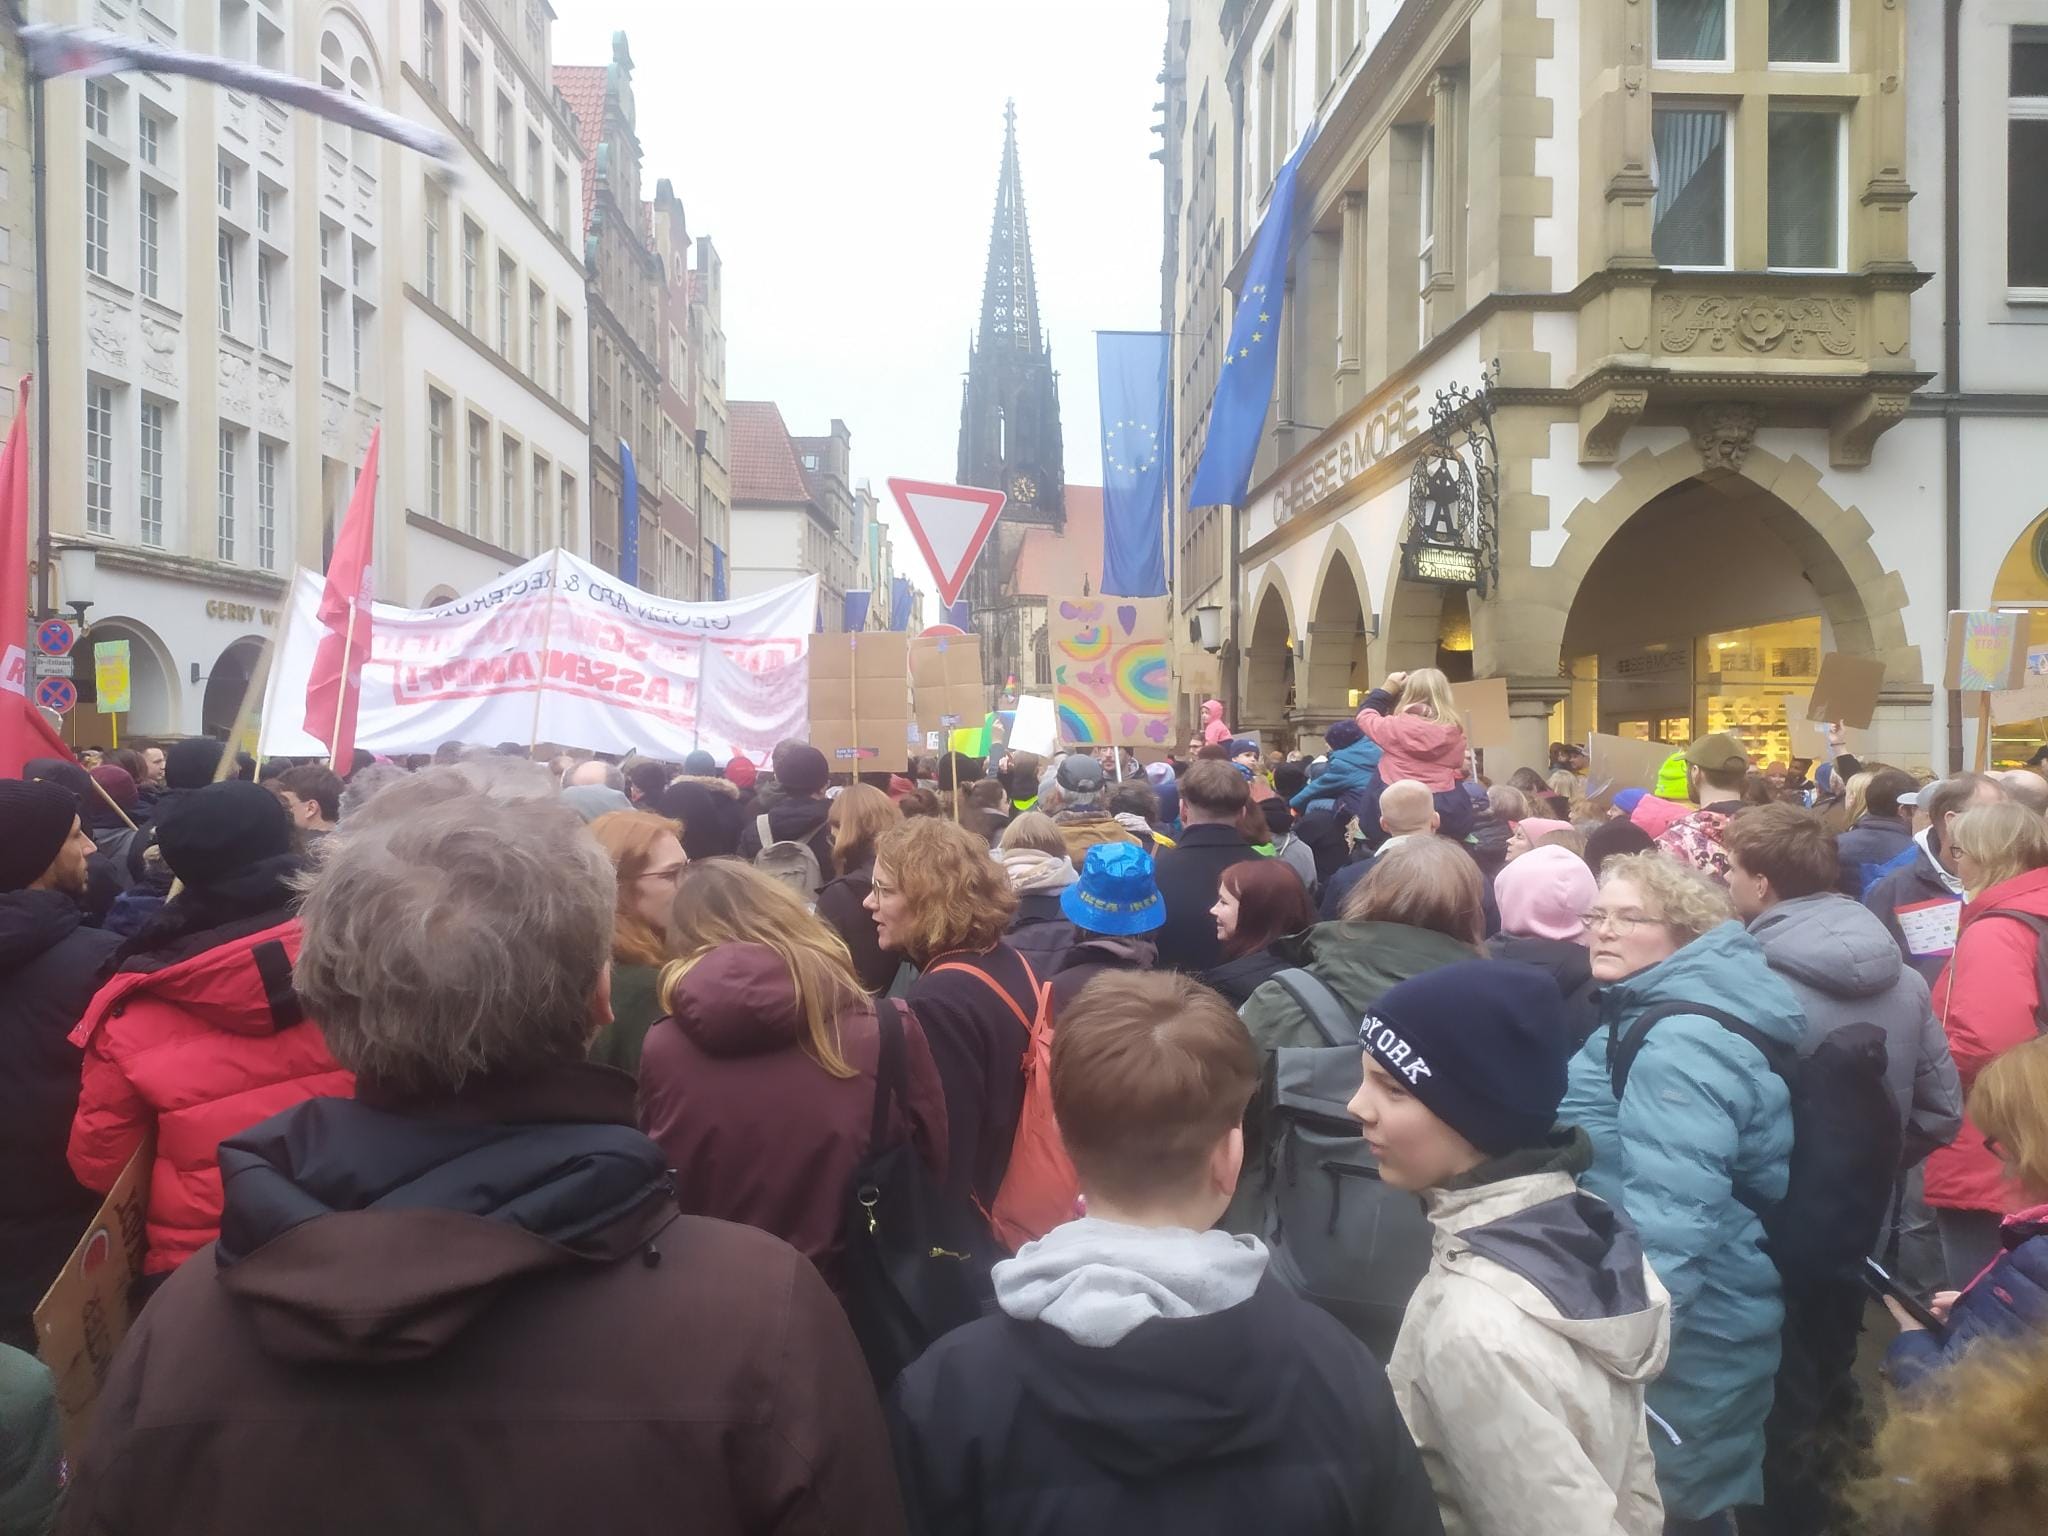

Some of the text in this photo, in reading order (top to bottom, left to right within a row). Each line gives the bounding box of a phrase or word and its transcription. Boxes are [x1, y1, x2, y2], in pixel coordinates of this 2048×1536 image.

[1273, 448, 1339, 527] CHEESE
[1354, 384, 1421, 473] MORE
[206, 600, 256, 622] GERRY
[1366, 1016, 1432, 1084] YORK
